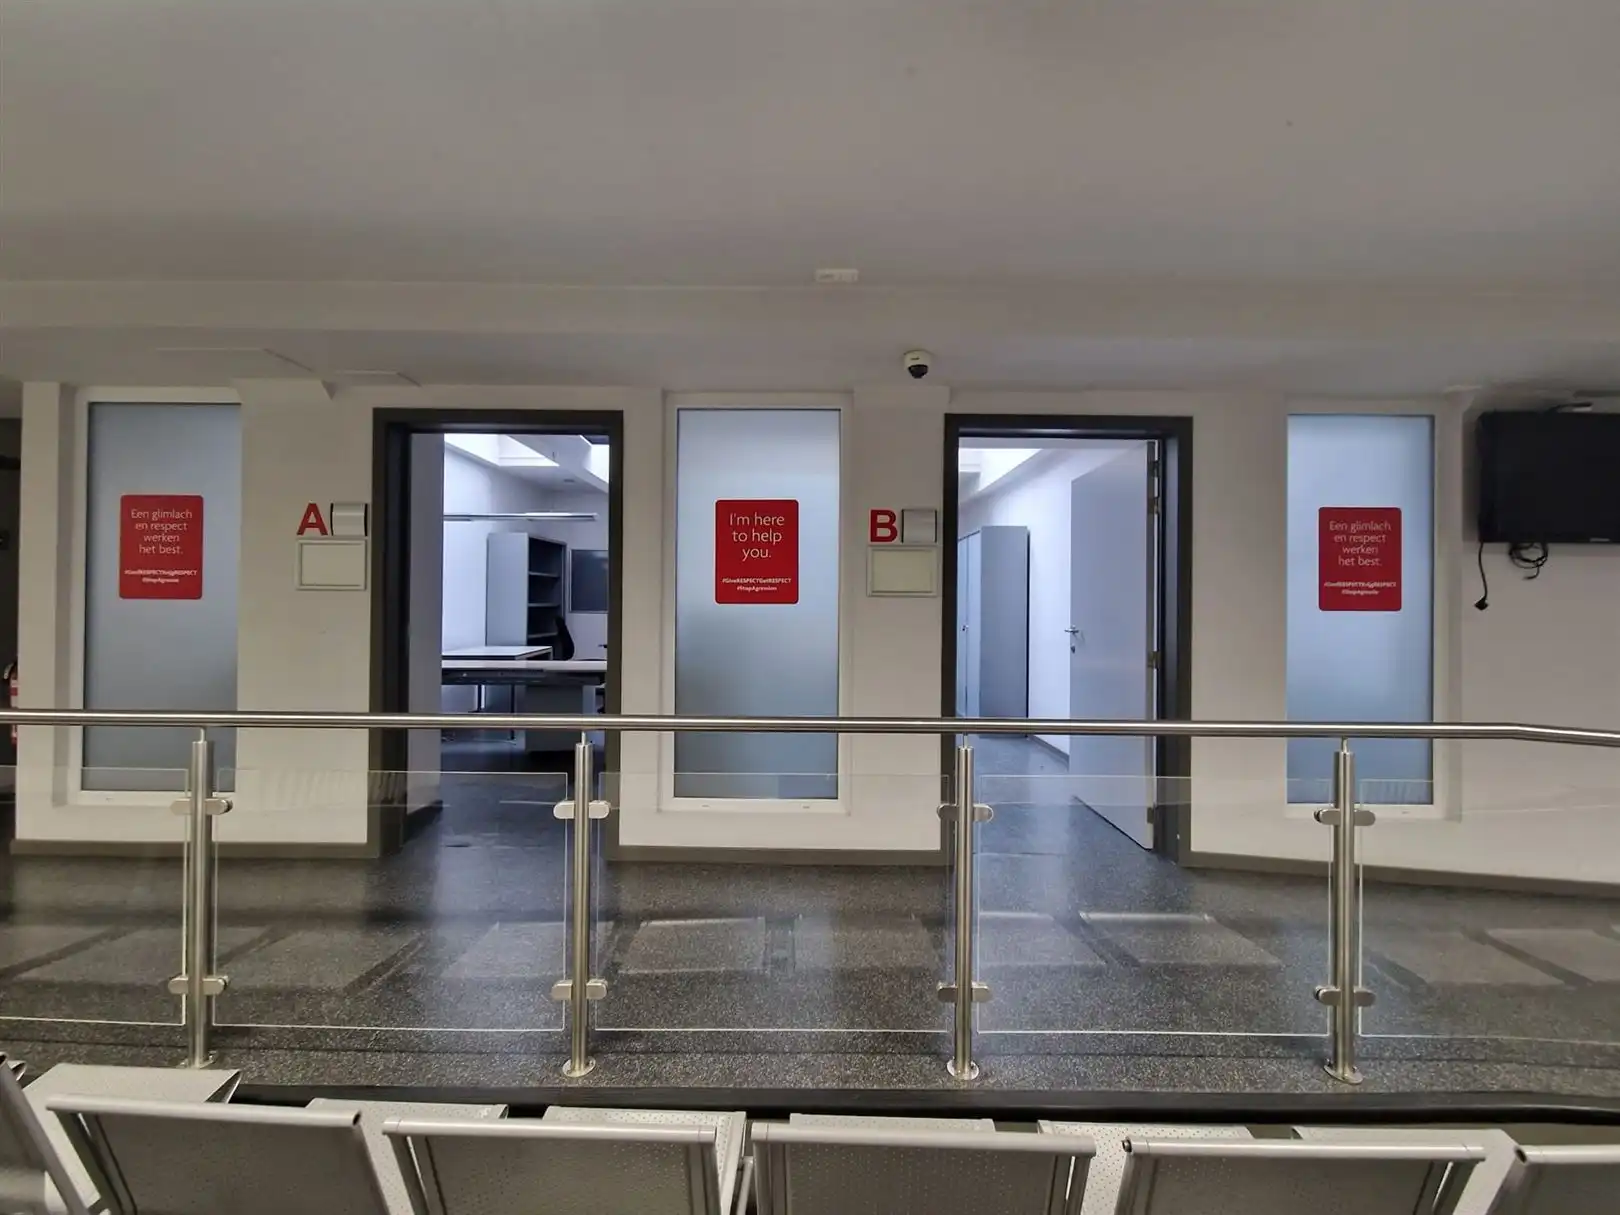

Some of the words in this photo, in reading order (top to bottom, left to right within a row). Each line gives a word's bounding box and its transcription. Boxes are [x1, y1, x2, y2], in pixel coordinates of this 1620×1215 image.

[131, 508, 149, 519] Een
[152, 508, 193, 521] glimlach
[297, 503, 328, 535] A
[729, 513, 750, 526] I'm
[754, 512, 785, 526] here
[135, 522, 148, 530] en
[150, 522, 188, 532] respect
[870, 510, 898, 542] B
[1329, 520, 1348, 531] Een
[1350, 520, 1392, 534] glimlach
[143, 533, 180, 542] werken
[732, 530, 748, 542] to
[752, 528, 782, 546] help
[1334, 534, 1347, 543] en
[1349, 534, 1387, 545] respect
[139, 543, 156, 554] het
[159, 543, 183, 554] best.
[742, 548, 772, 562] you.
[1342, 544, 1379, 555] werken
[1338, 555, 1355, 566] het
